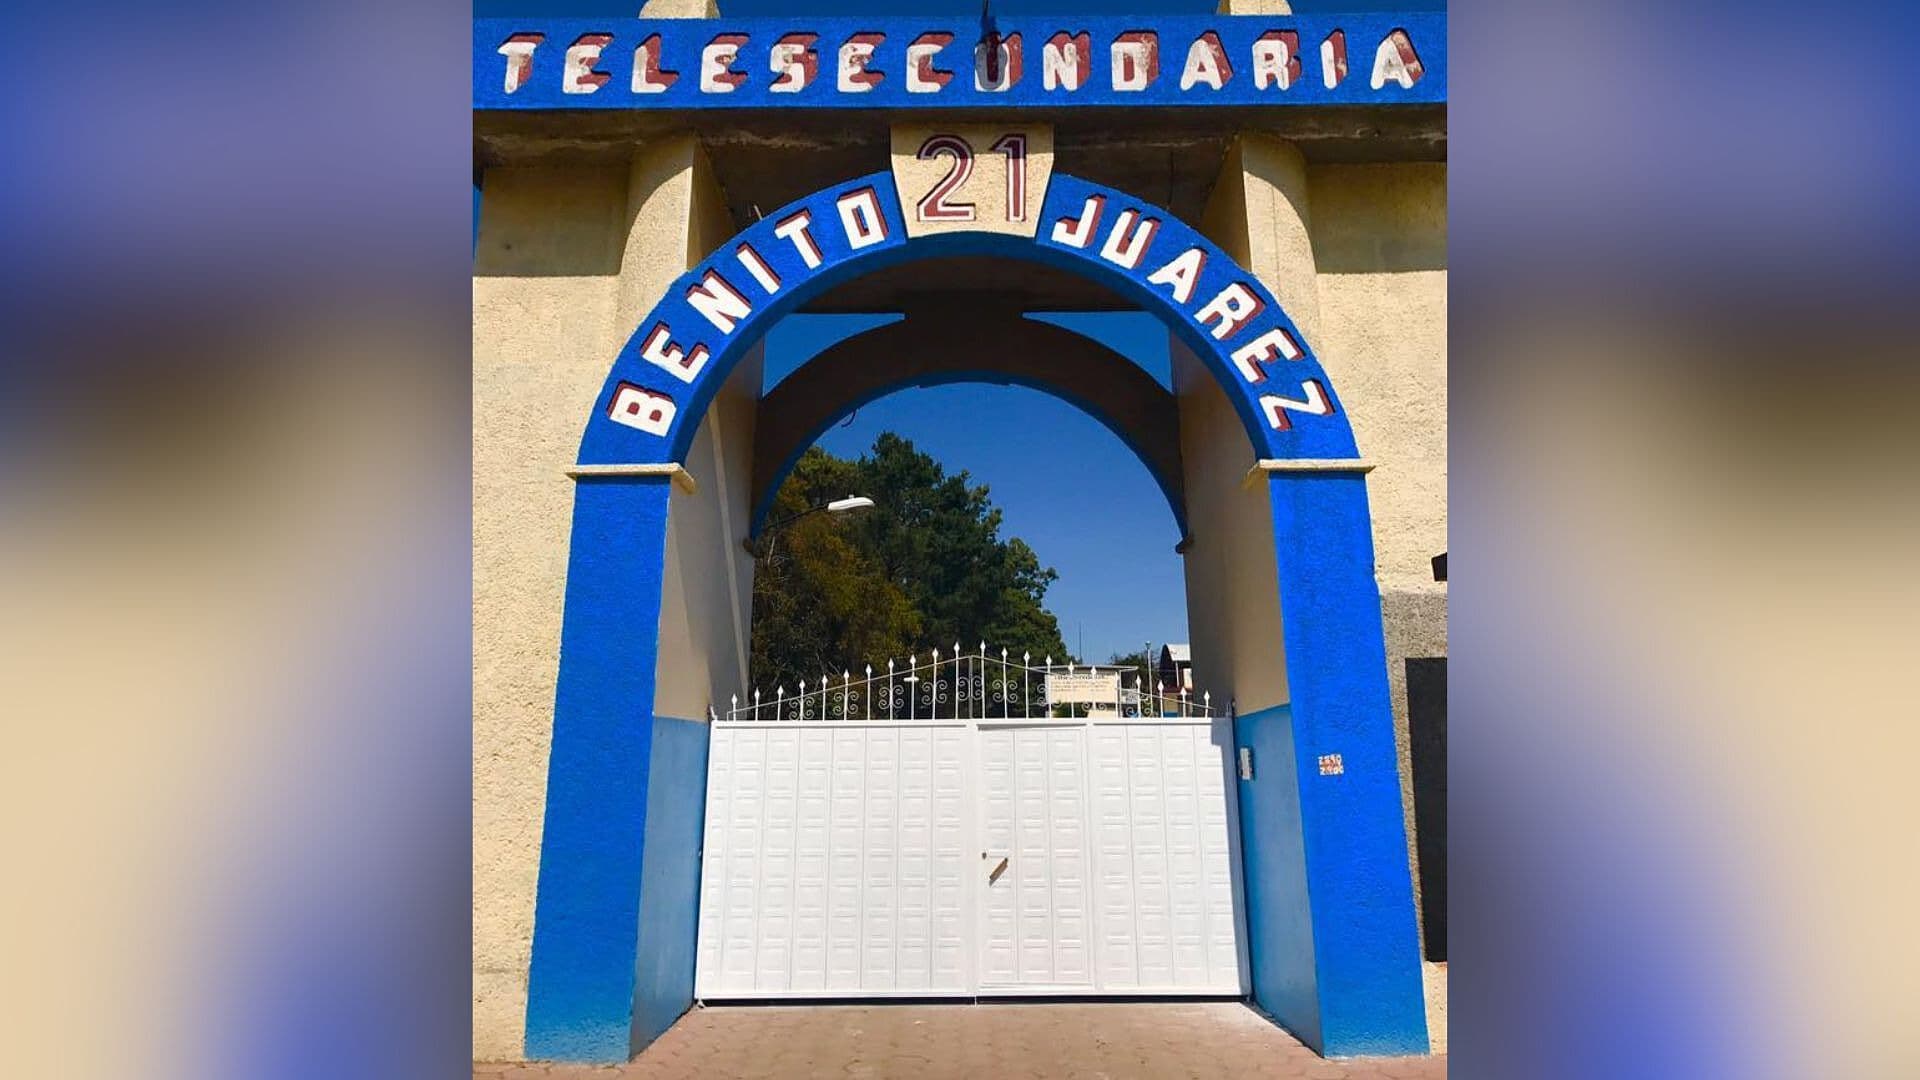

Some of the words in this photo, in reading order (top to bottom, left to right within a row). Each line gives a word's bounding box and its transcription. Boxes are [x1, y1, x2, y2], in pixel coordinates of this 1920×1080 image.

[497, 28, 1426, 94] TELESECUNDARIA
[914, 133, 1027, 223] 21
[607, 184, 890, 437] BENITO
[1051, 193, 1336, 431] JUAREZ
